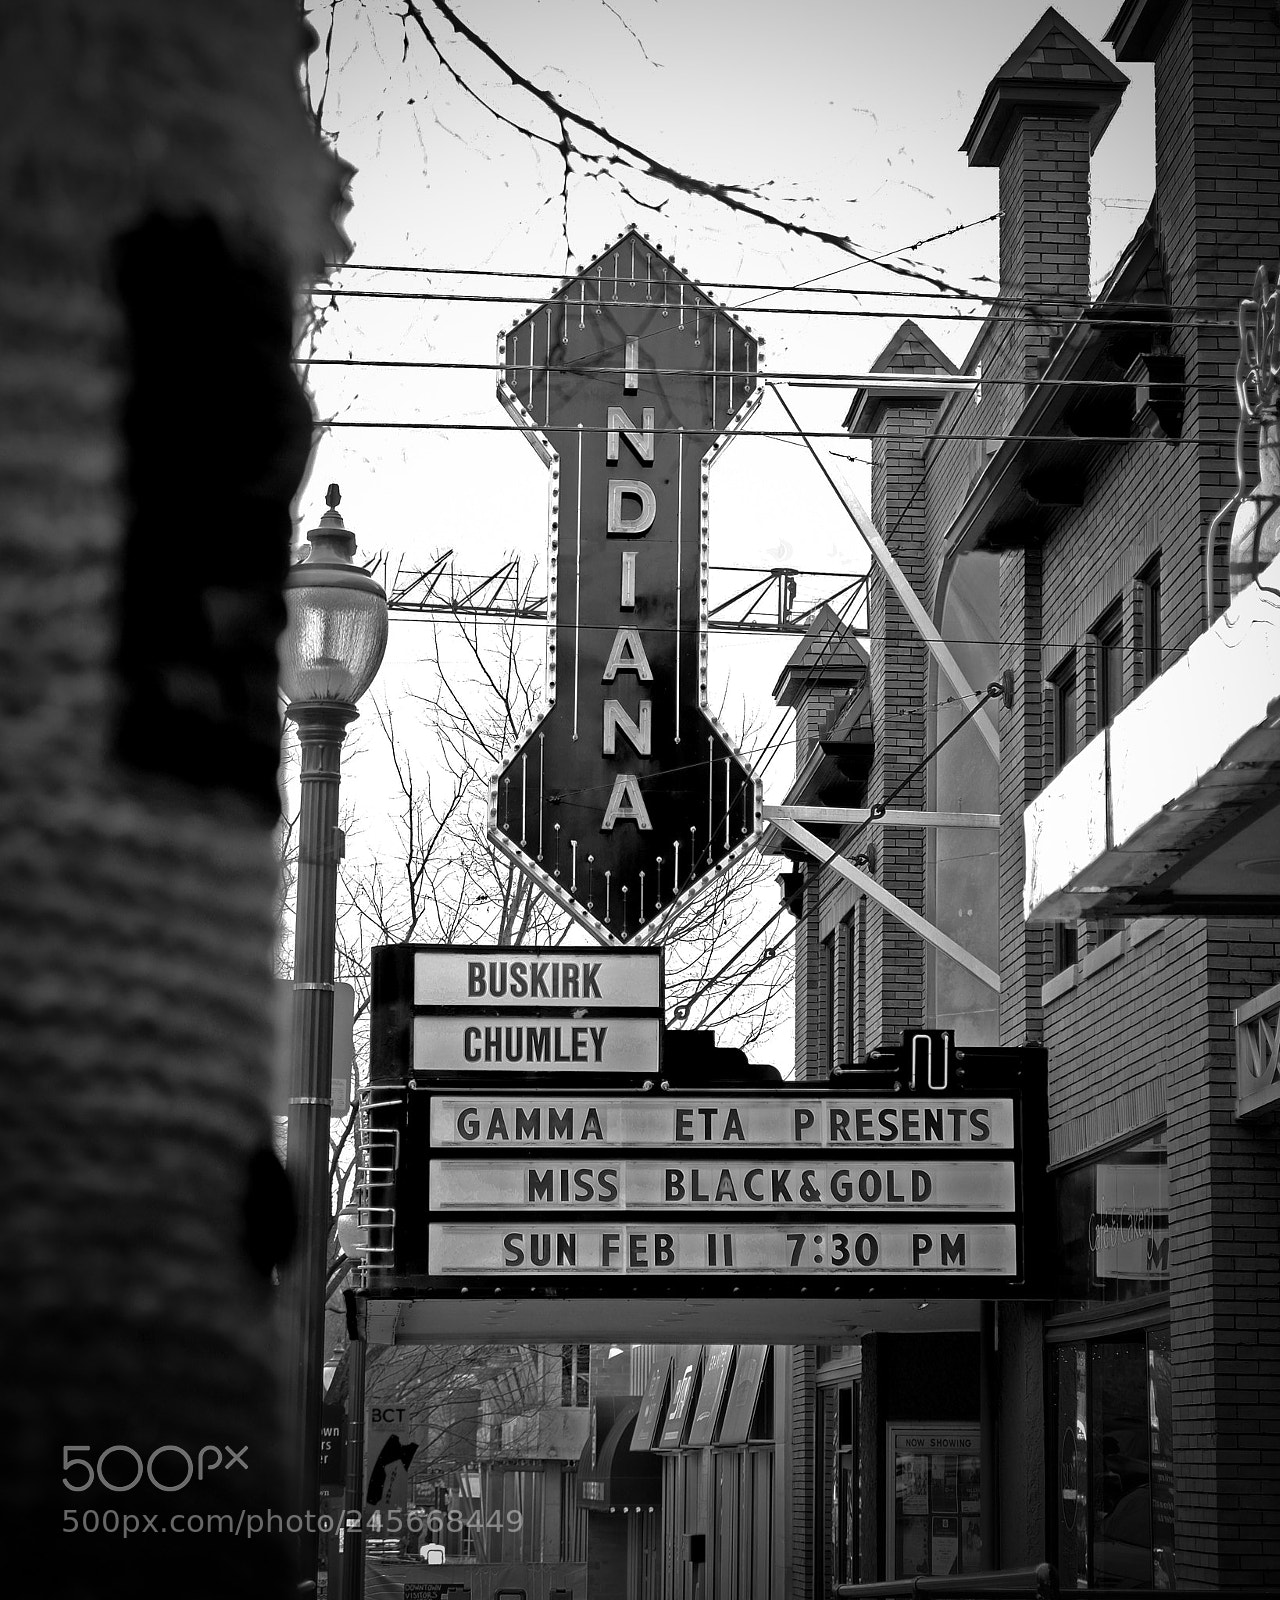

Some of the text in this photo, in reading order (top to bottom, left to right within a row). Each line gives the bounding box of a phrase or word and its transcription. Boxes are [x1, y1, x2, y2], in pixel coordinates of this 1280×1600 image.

[601, 334, 657, 831] INDIANA
[468, 960, 603, 1000] BUSKIRK
[463, 1026, 608, 1064] CHUMLEY
[456, 1107, 605, 1143] GAMMA
[674, 1107, 747, 1143] ETA
[526, 1168, 934, 1205] MISS BLACK&GOLD
[503, 1233, 968, 1268] SUN FEB 11 7:30 PM
[371, 1408, 406, 1423] BCT
[905, 1439, 972, 1448] NOW SHOWING
